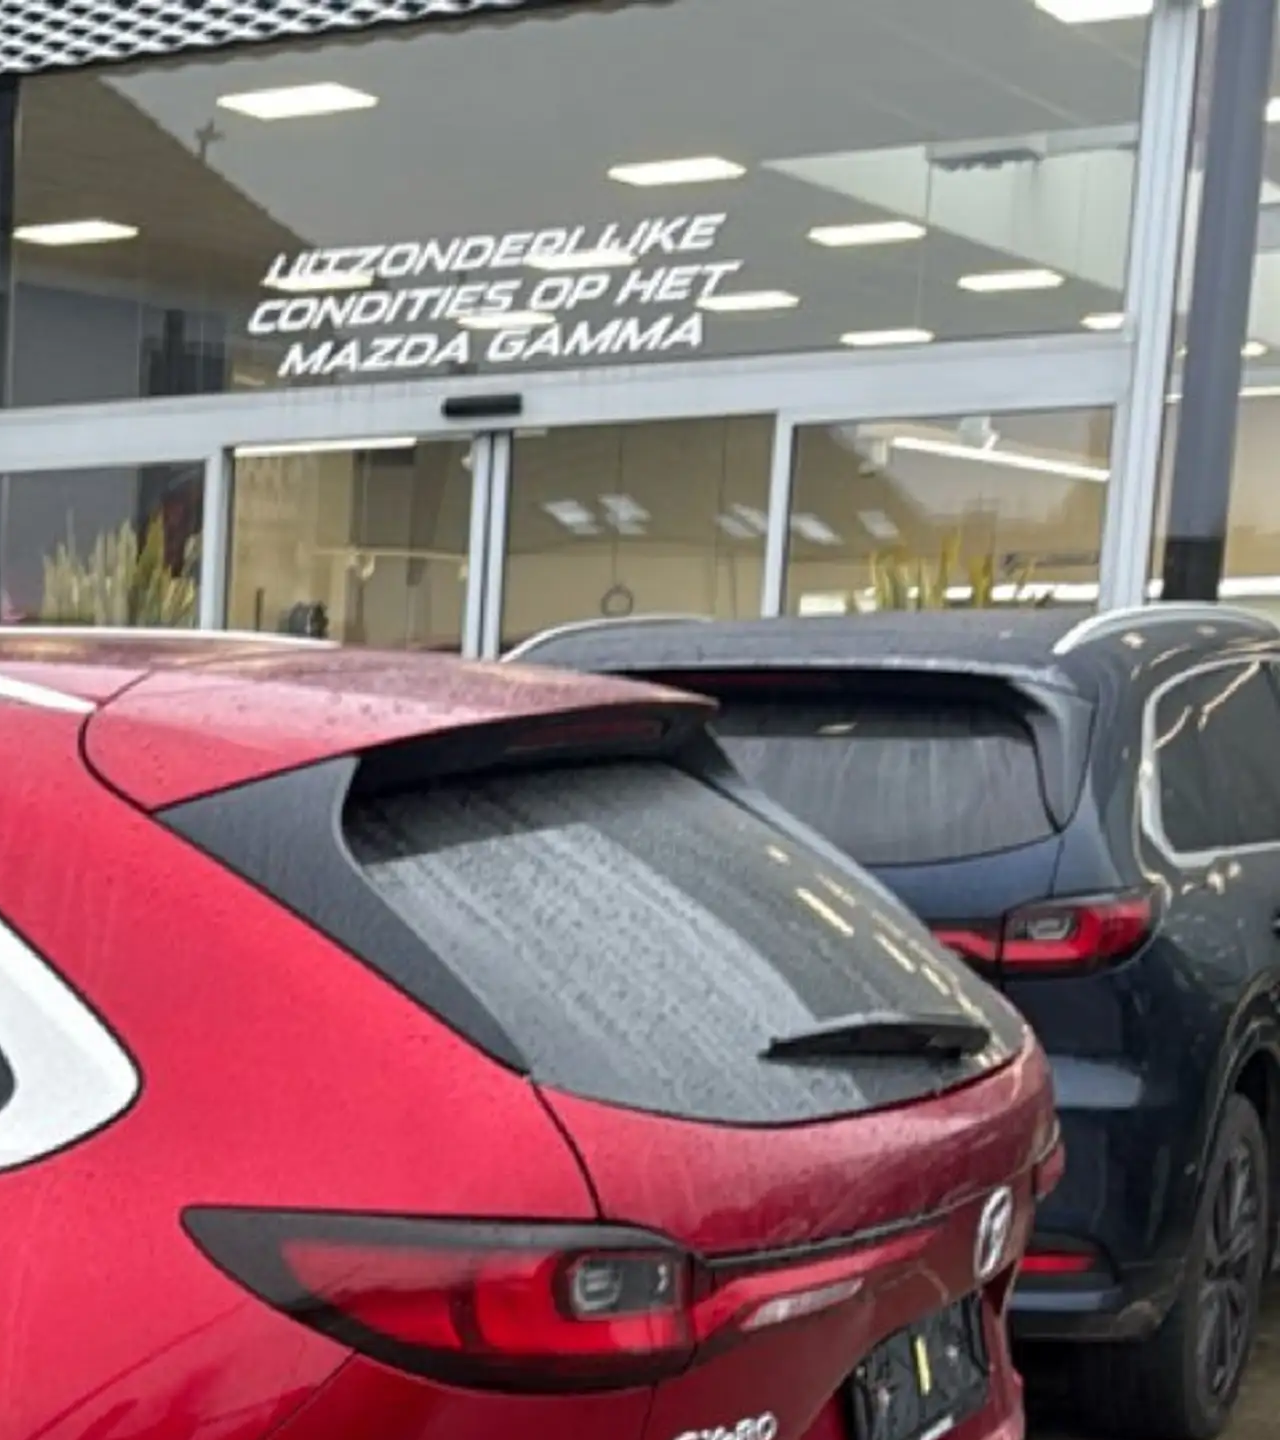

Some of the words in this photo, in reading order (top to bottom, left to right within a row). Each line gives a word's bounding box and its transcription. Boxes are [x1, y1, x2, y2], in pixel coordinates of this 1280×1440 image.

[265, 212, 727, 282] UITZONDERLIJKE
[247, 279, 524, 334] CONDITIES
[529, 274, 611, 312] OP
[614, 259, 744, 306] HET
[278, 330, 471, 378] MAZDA
[485, 312, 703, 363] GAMMA
